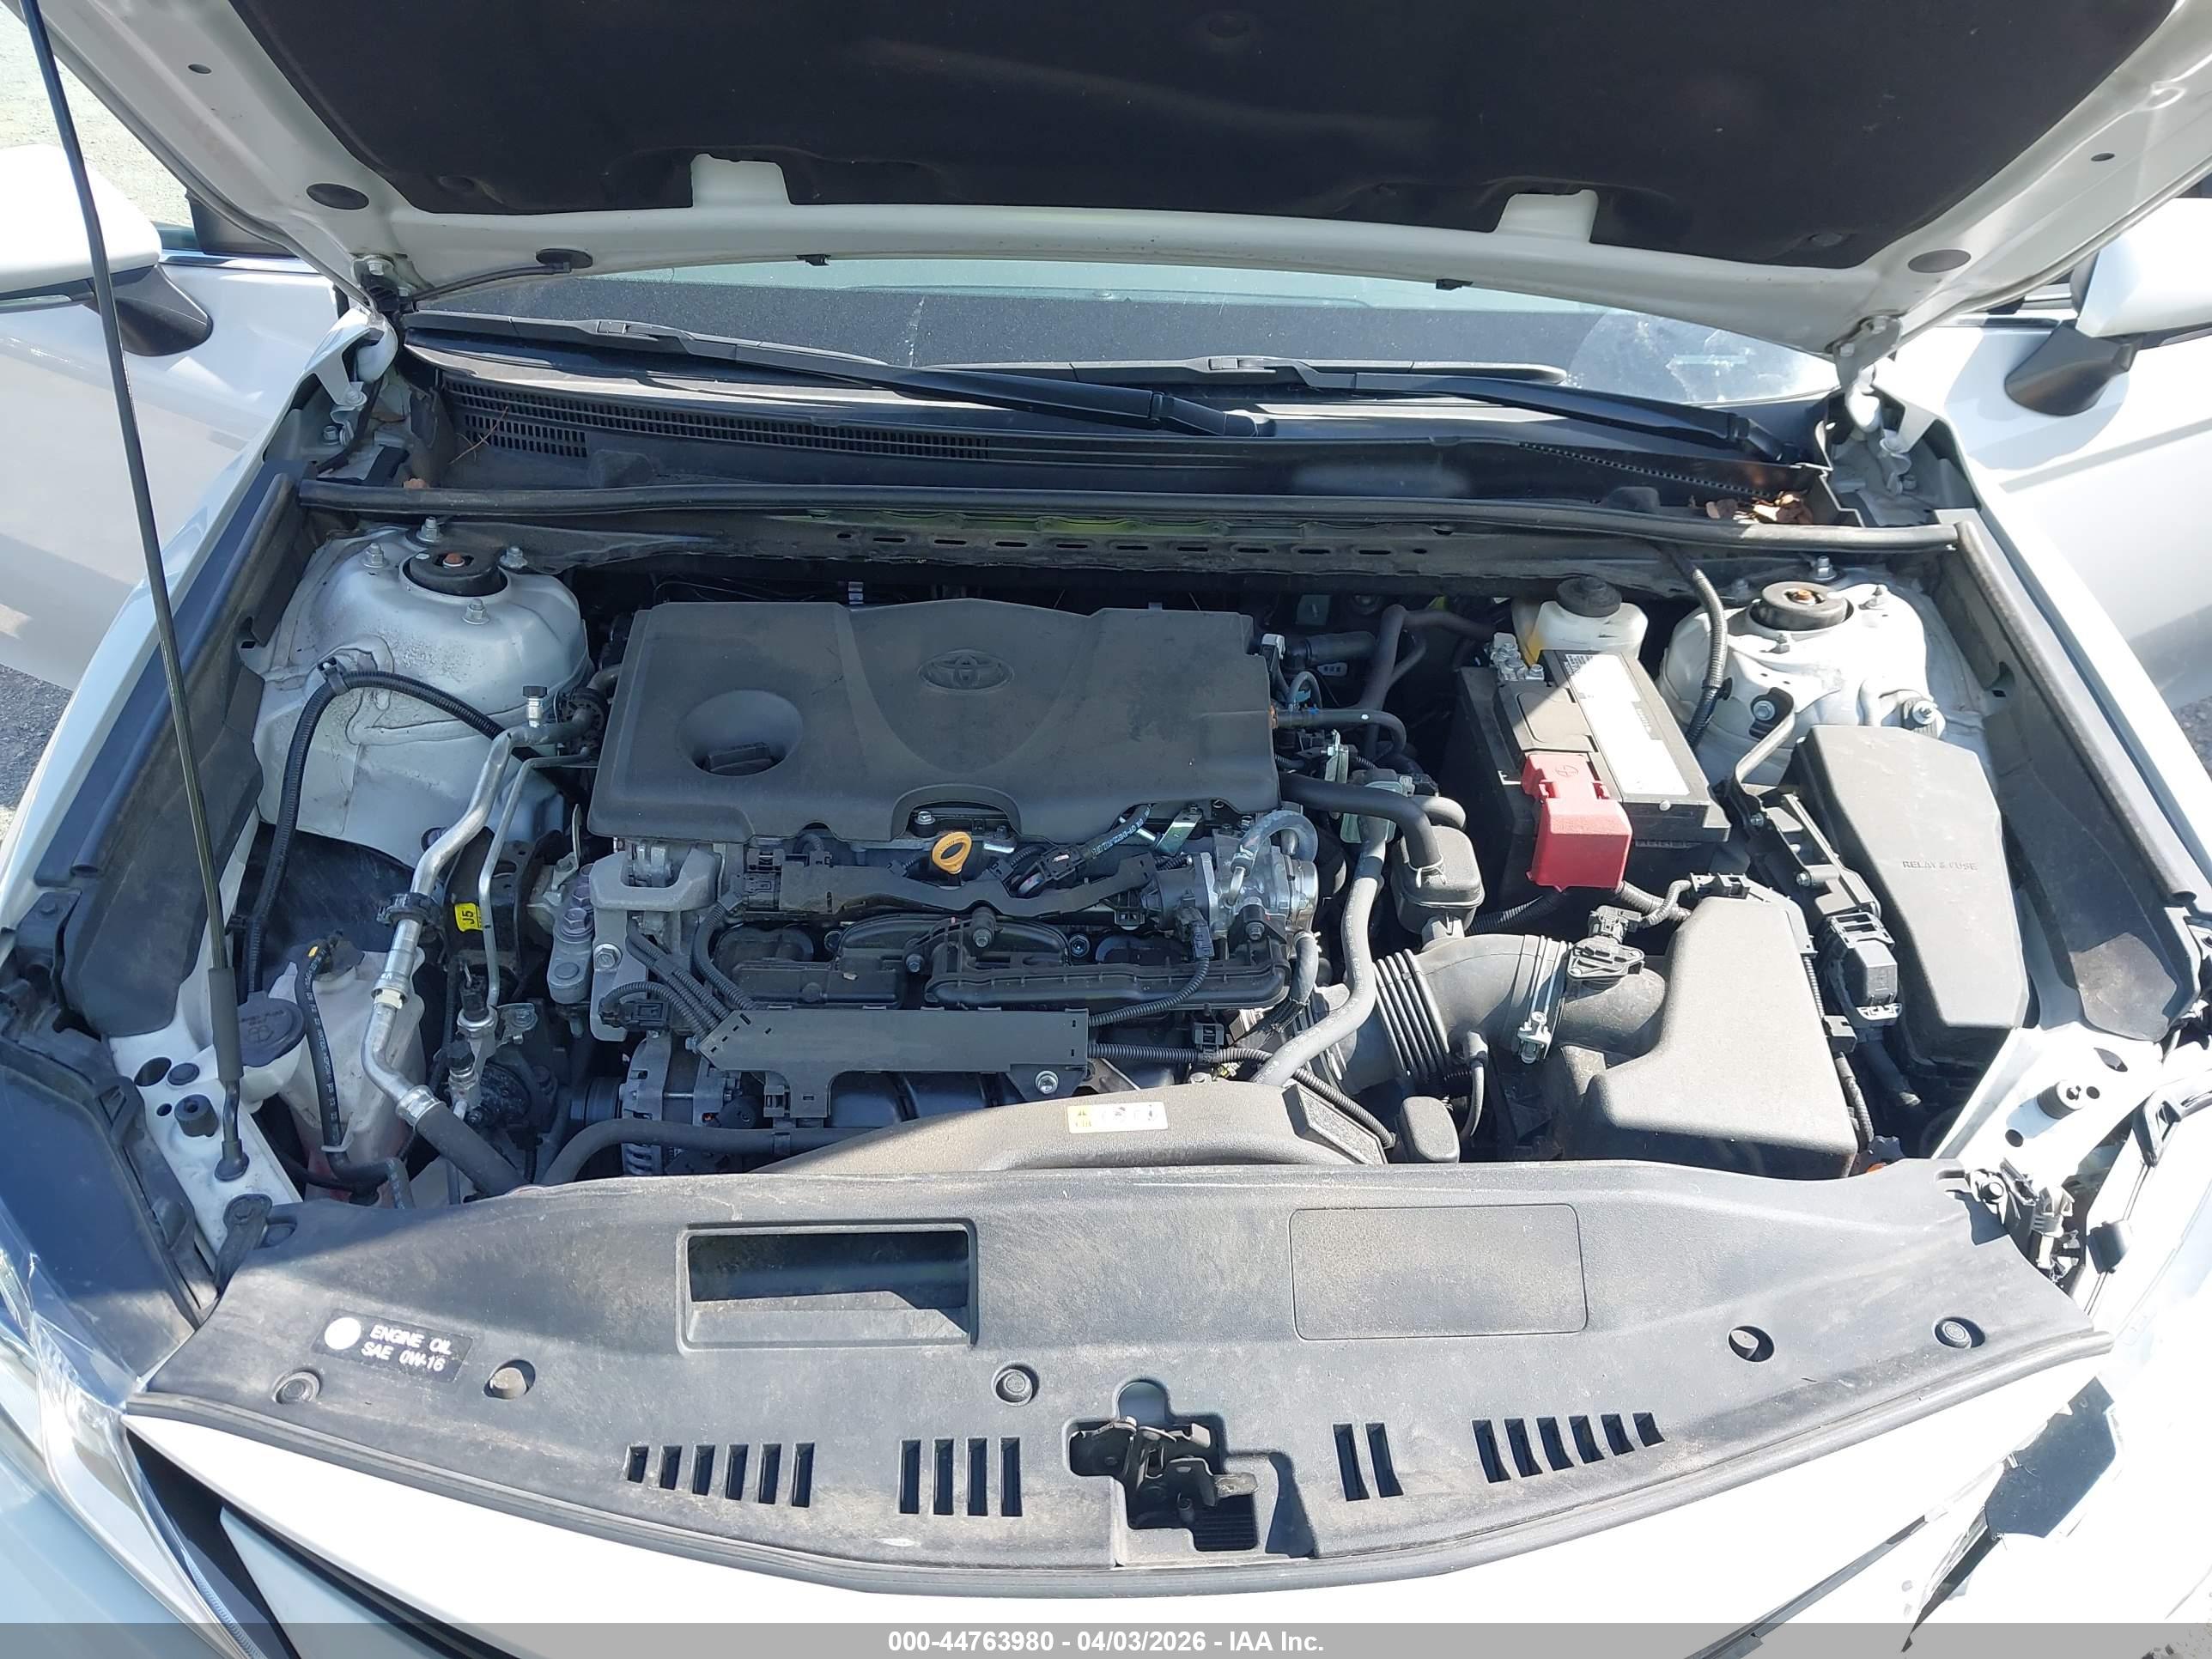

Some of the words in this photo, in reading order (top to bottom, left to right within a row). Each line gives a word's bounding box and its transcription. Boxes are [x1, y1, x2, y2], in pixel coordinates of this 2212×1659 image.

[1902, 860, 1936, 869] RELAY
[1949, 862, 1978, 871] FUSE
[461, 910, 475, 924] J5
[369, 1324, 425, 1348] ENGINE
[428, 1337, 453, 1355] OIL
[361, 1342, 394, 1360] SAE
[398, 1349, 446, 1372] 0W-16
